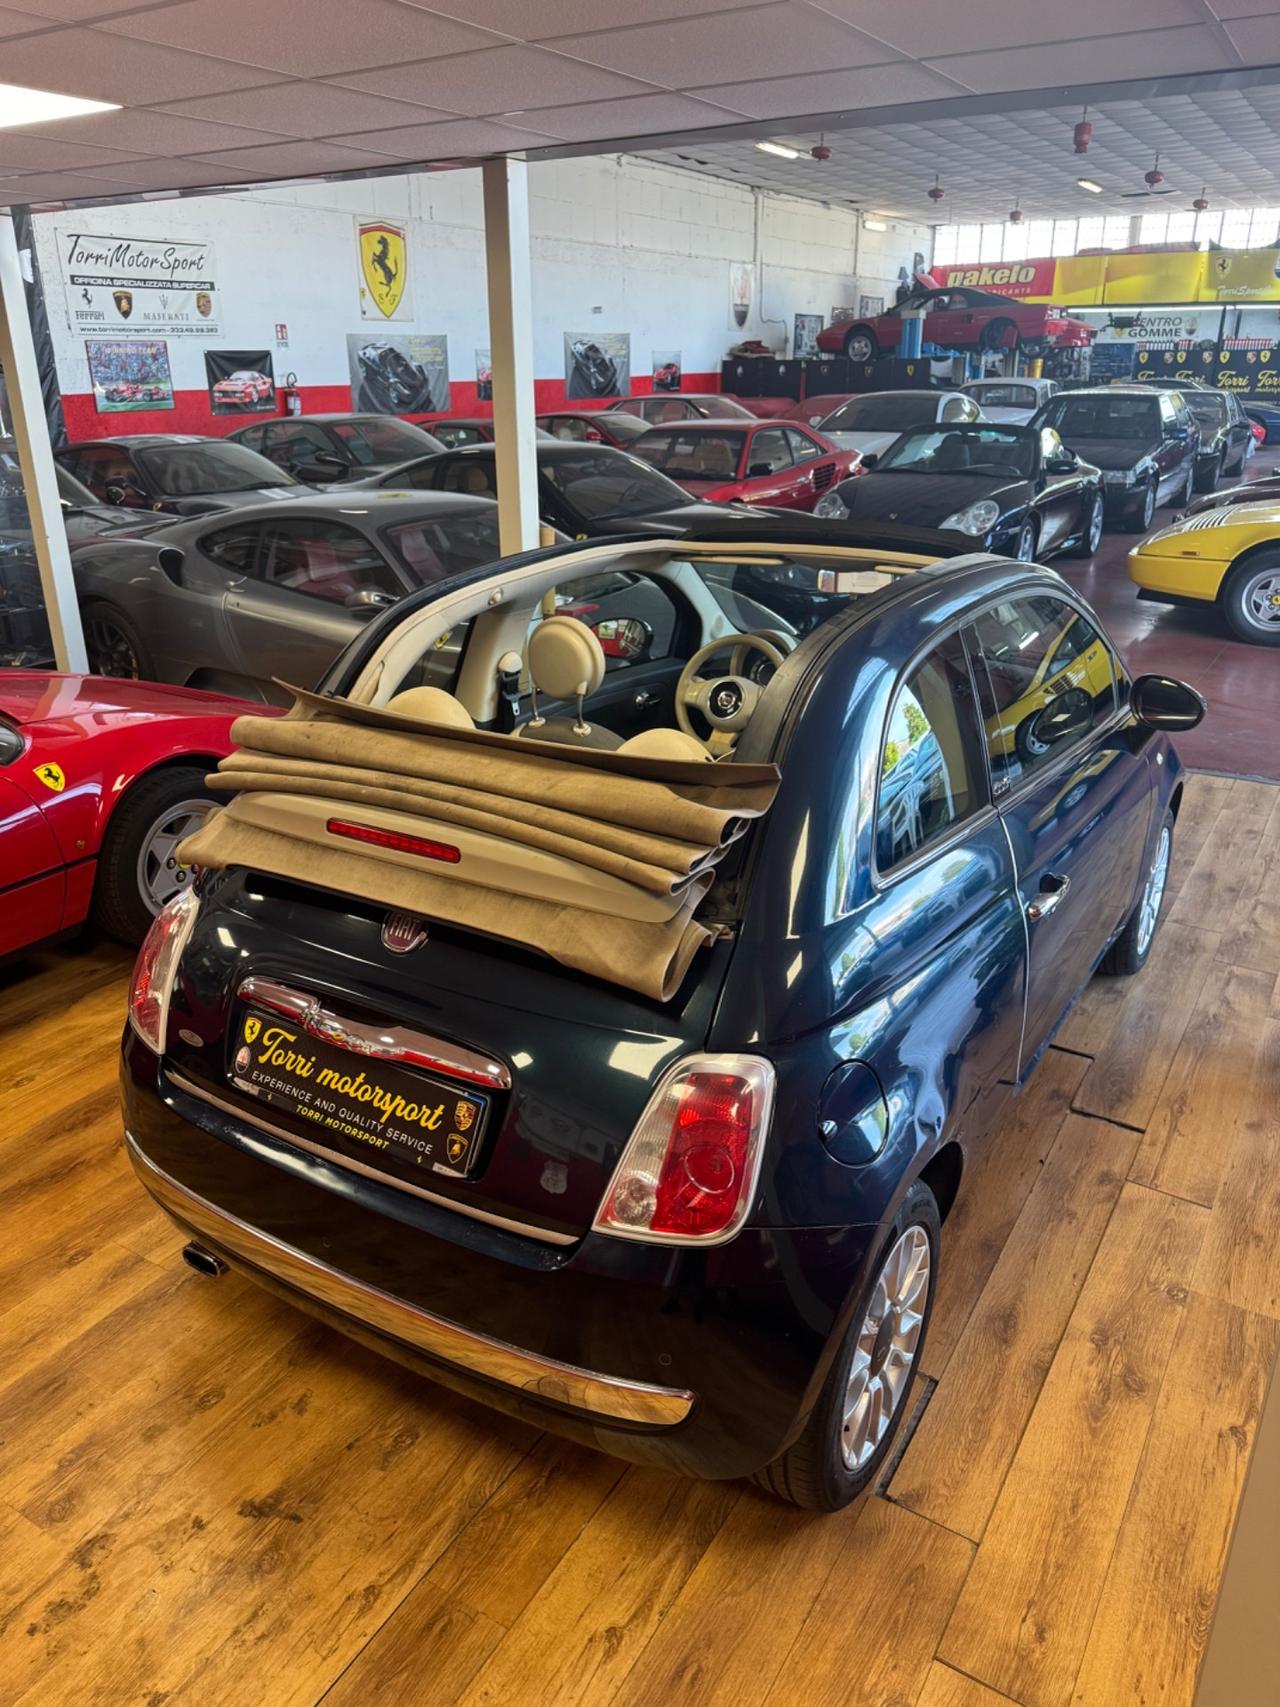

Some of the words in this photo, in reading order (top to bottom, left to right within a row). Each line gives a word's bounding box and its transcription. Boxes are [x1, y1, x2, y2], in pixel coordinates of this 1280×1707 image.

[73, 277, 112, 286] OFFICINA
[113, 279, 172, 288] SPECIALIZZATA
[172, 281, 211, 290] SUPERCAR
[946, 264, 1036, 288] pakelo
[143, 312, 190, 321] MASERATI
[1128, 327, 1182, 338] GOMME
[1217, 370, 1249, 388] Torri
[258, 1028, 316, 1078] Torri
[316, 1068, 445, 1131] motorsport
[251, 1070, 312, 1103] EXPERIENCE
[313, 1097, 336, 1113] AND
[338, 1107, 384, 1133] QUALITY
[385, 1127, 433, 1155] SERVICE
[296, 1104, 324, 1122] TORRI
[324, 1116, 390, 1150] MOTORSPORT
